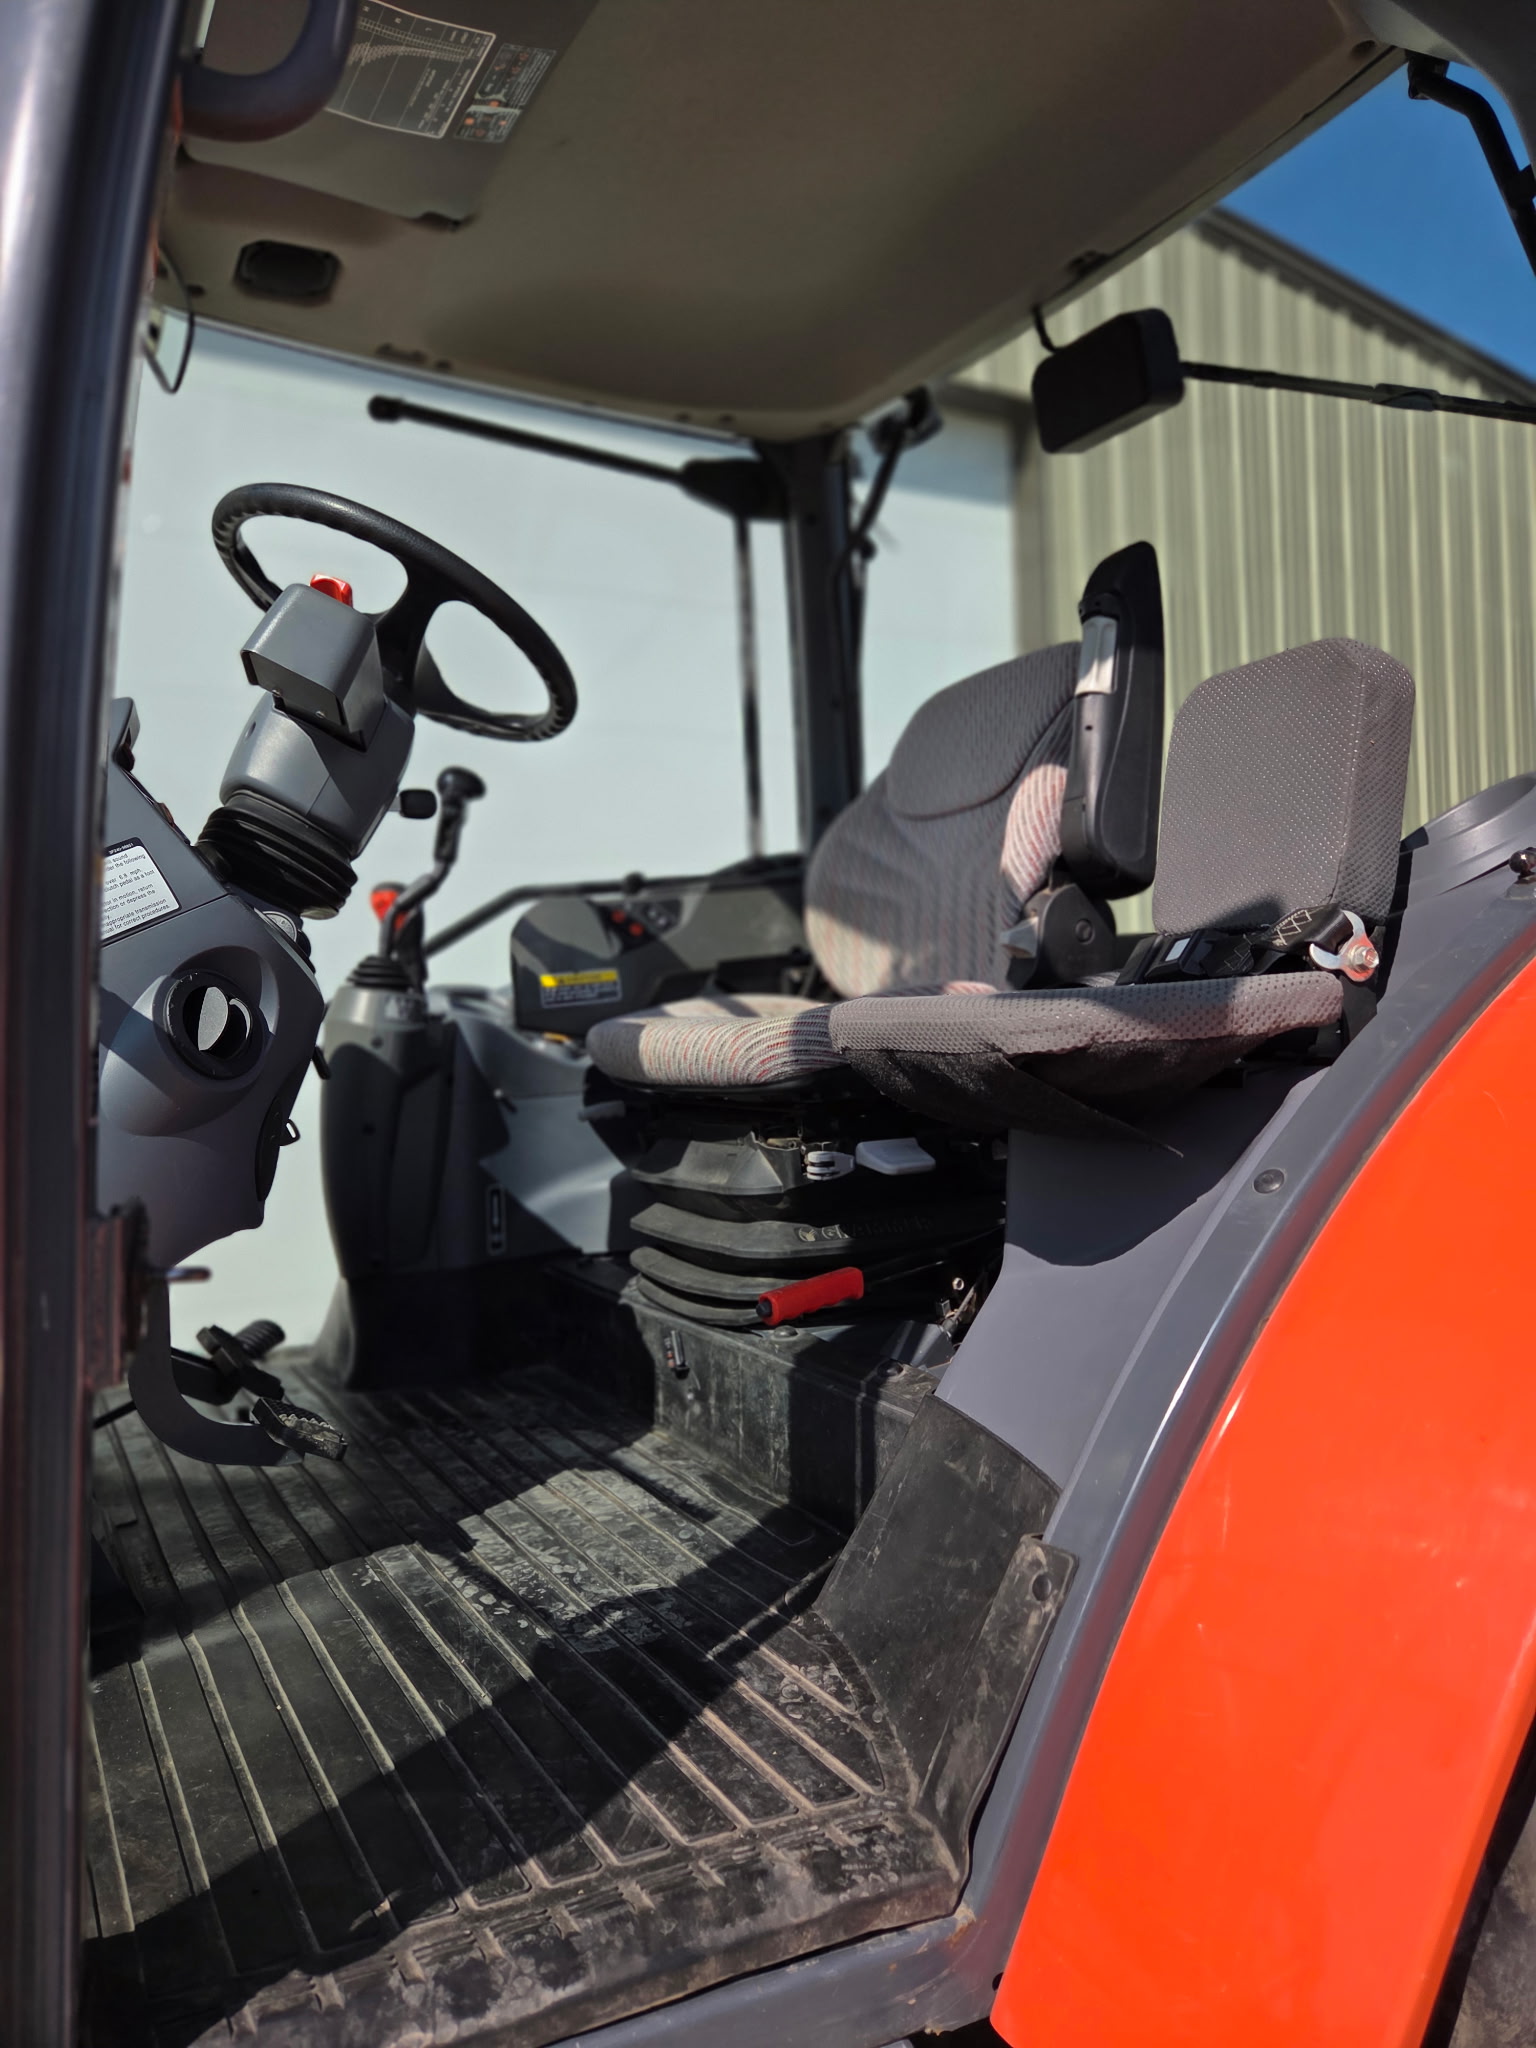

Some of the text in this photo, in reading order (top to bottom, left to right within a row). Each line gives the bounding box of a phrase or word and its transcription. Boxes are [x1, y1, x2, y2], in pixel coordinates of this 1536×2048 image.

[123, 854, 145, 865] following
[119, 878, 133, 888] pedal
[144, 869, 155, 877] foot
[138, 884, 153, 892] return
[103, 904, 119, 913] ection
[127, 893, 147, 903] depress
[134, 899, 166, 914] transmission
[123, 915, 141, 926] correct
